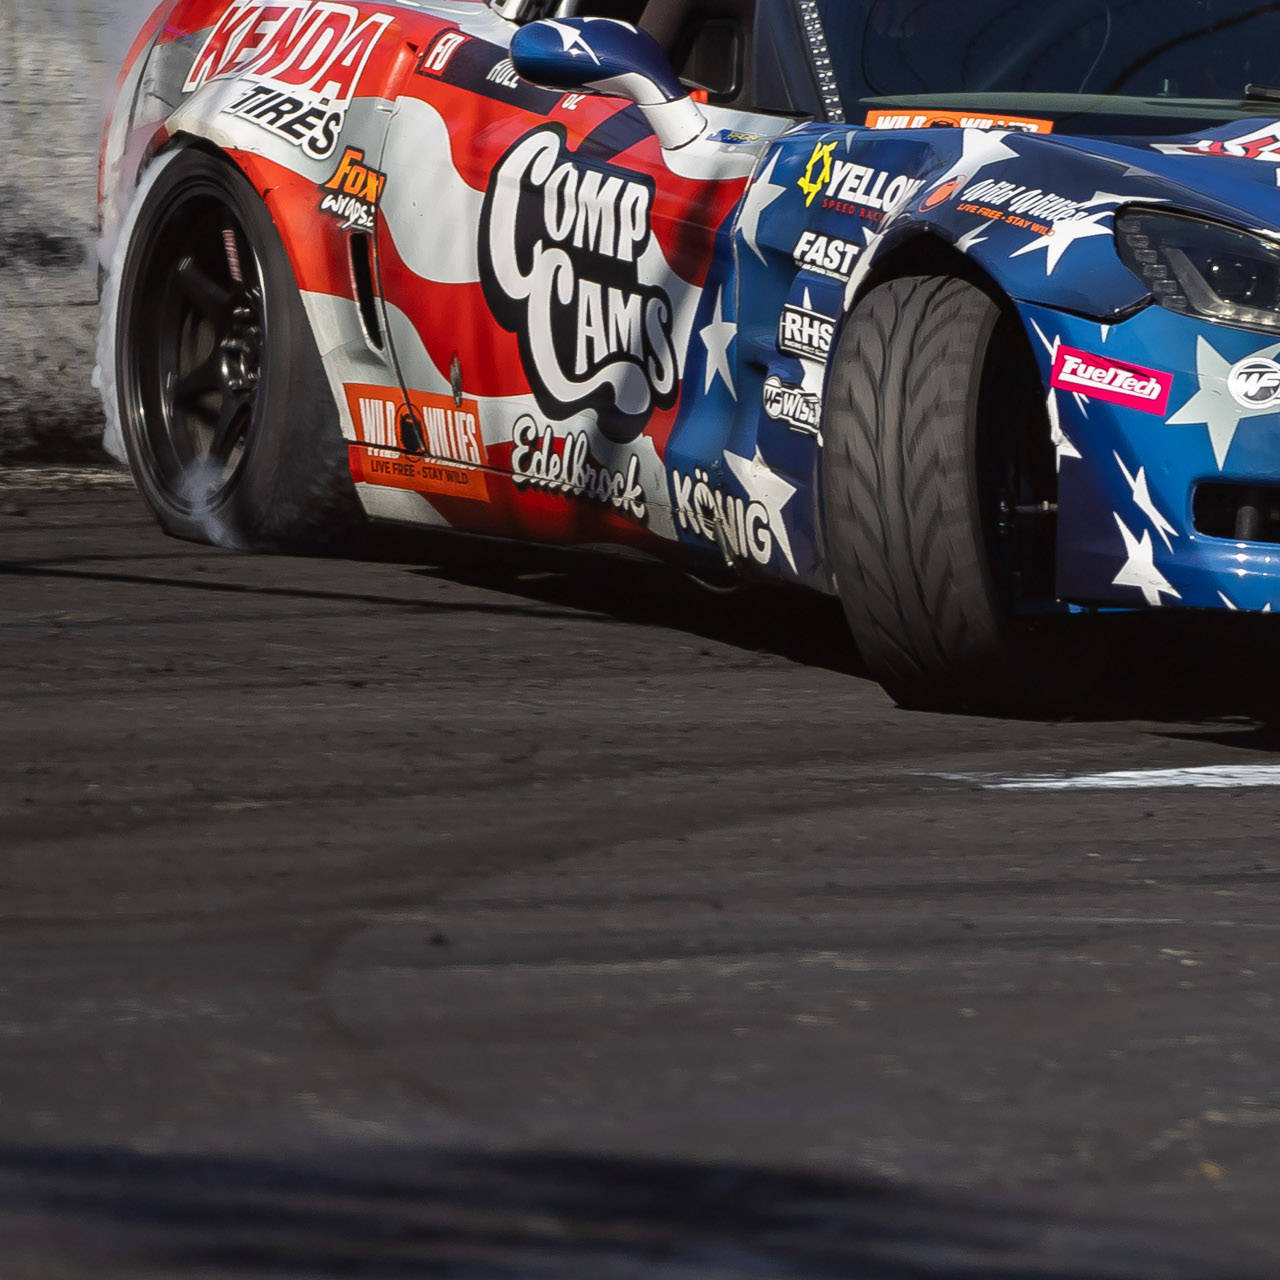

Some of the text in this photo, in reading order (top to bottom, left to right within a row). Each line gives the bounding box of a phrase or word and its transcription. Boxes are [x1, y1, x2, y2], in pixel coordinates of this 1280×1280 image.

[184, 0, 393, 107] KENDA
[229, 85, 343, 157] TIRES
[822, 198, 856, 216] SPEED
[825, 160, 926, 213] YELLOW
[490, 130, 650, 300] COMP
[793, 231, 862, 274] FAST
[527, 239, 675, 415] CAMS
[784, 310, 835, 352] RHS
[1063, 353, 1163, 399] FuelTech
[370, 459, 390, 474] LIVE
[391, 462, 416, 477] FREE
[421, 466, 443, 482] STAY
